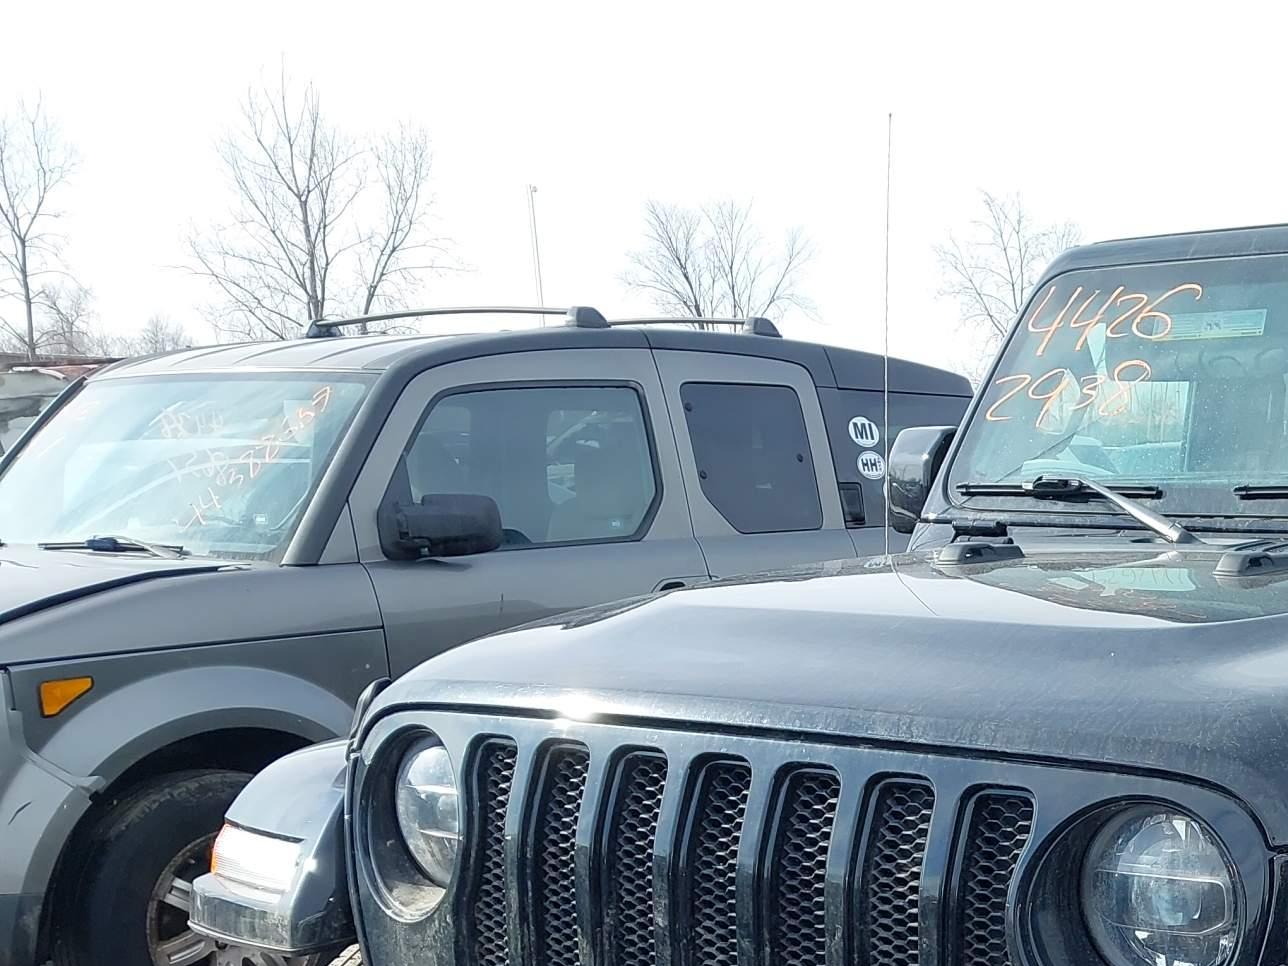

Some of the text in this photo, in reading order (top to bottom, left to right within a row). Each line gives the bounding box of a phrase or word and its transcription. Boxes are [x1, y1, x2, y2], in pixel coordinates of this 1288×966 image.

[1028, 283, 1203, 357] 4426
[985, 360, 1152, 429] 2938
[852, 421, 875, 441] MI
[861, 457, 878, 472] HH
